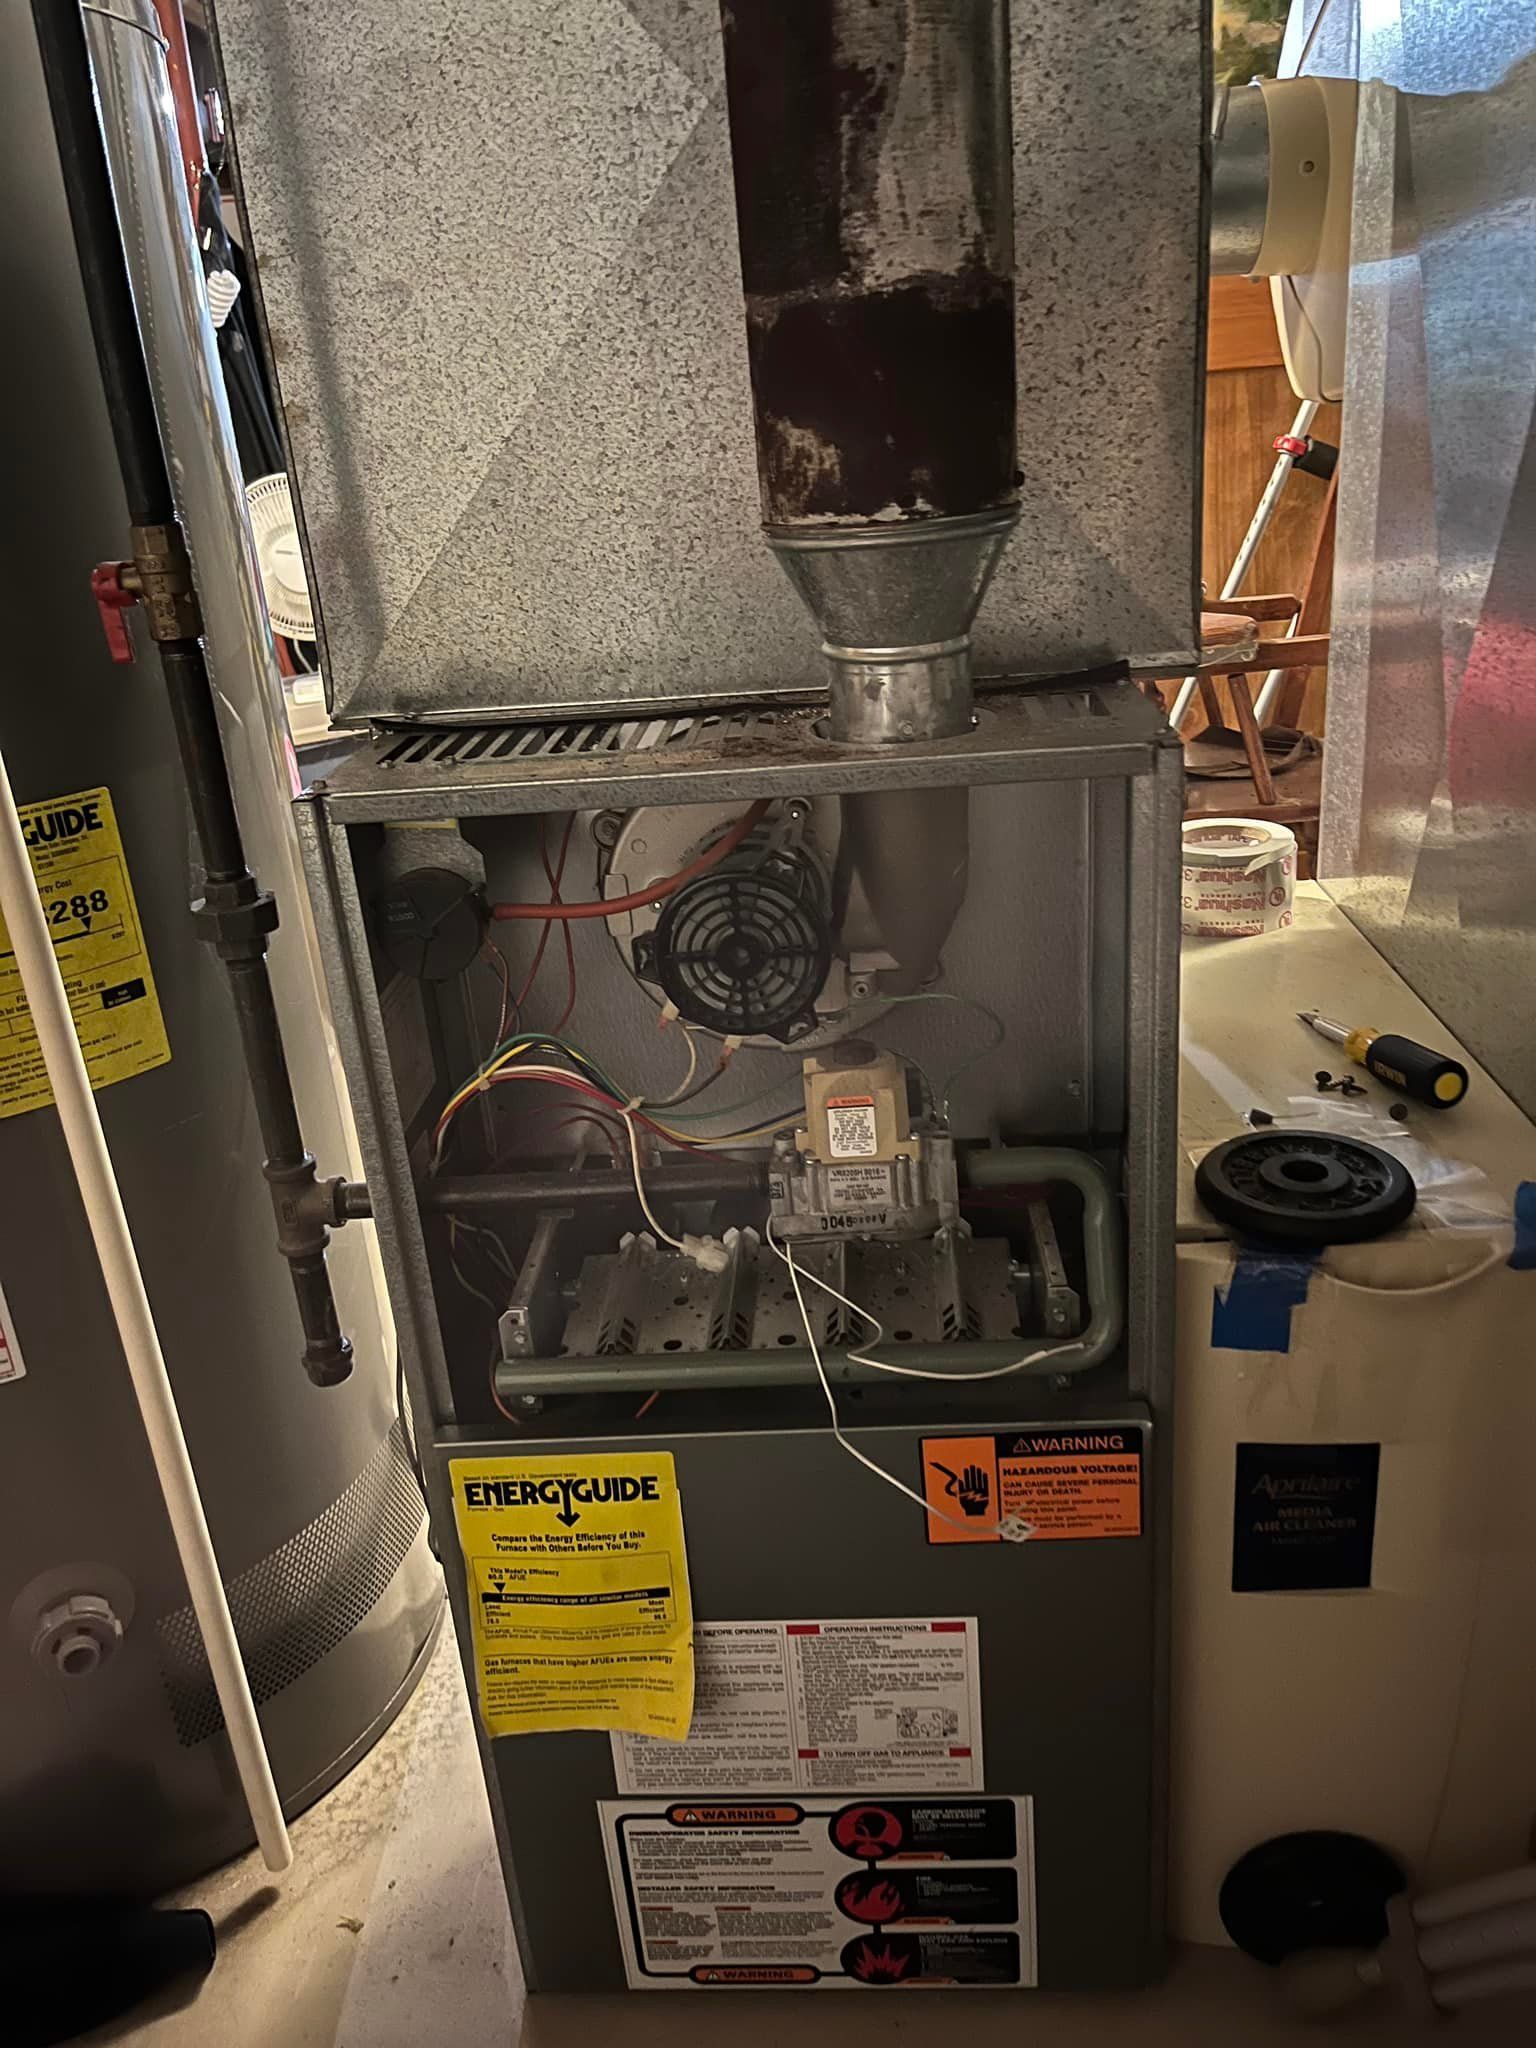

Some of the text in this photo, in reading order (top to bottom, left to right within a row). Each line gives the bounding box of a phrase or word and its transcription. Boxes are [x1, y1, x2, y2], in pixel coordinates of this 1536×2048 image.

[44, 889, 109, 927] 288
[1199, 897, 1266, 913] Nashua
[1373, 1059, 1408, 1088] IRWIN
[1031, 1434, 1124, 1452] WARNING
[1003, 1464, 1138, 1476] HAZARDOUS VOLTAGE!
[1003, 1478, 1138, 1489] CAN CAUSE SEVERE PERSONAL
[464, 1476, 660, 1509] ENERGYGUIDE
[1251, 1520, 1281, 1534] AIR
[491, 1530, 646, 1546] Compare the Energy Efficiency of this
[496, 1543, 528, 1552] Furnace
[530, 1543, 547, 1552] with
[549, 1543, 576, 1553] Others
[578, 1542, 604, 1552] Before
[606, 1541, 622, 1551] You
[734, 1627, 778, 1636] OPERATING
[823, 1624, 928, 1635] OPERATING INSTRUCTIONS
[485, 1658, 499, 1668] Gas
[533, 1657, 547, 1666] that
[548, 1657, 565, 1667] have
[485, 1666, 520, 1677] efficient.
[701, 1810, 777, 1820] WARNING
[723, 1969, 794, 1980] WARNING
